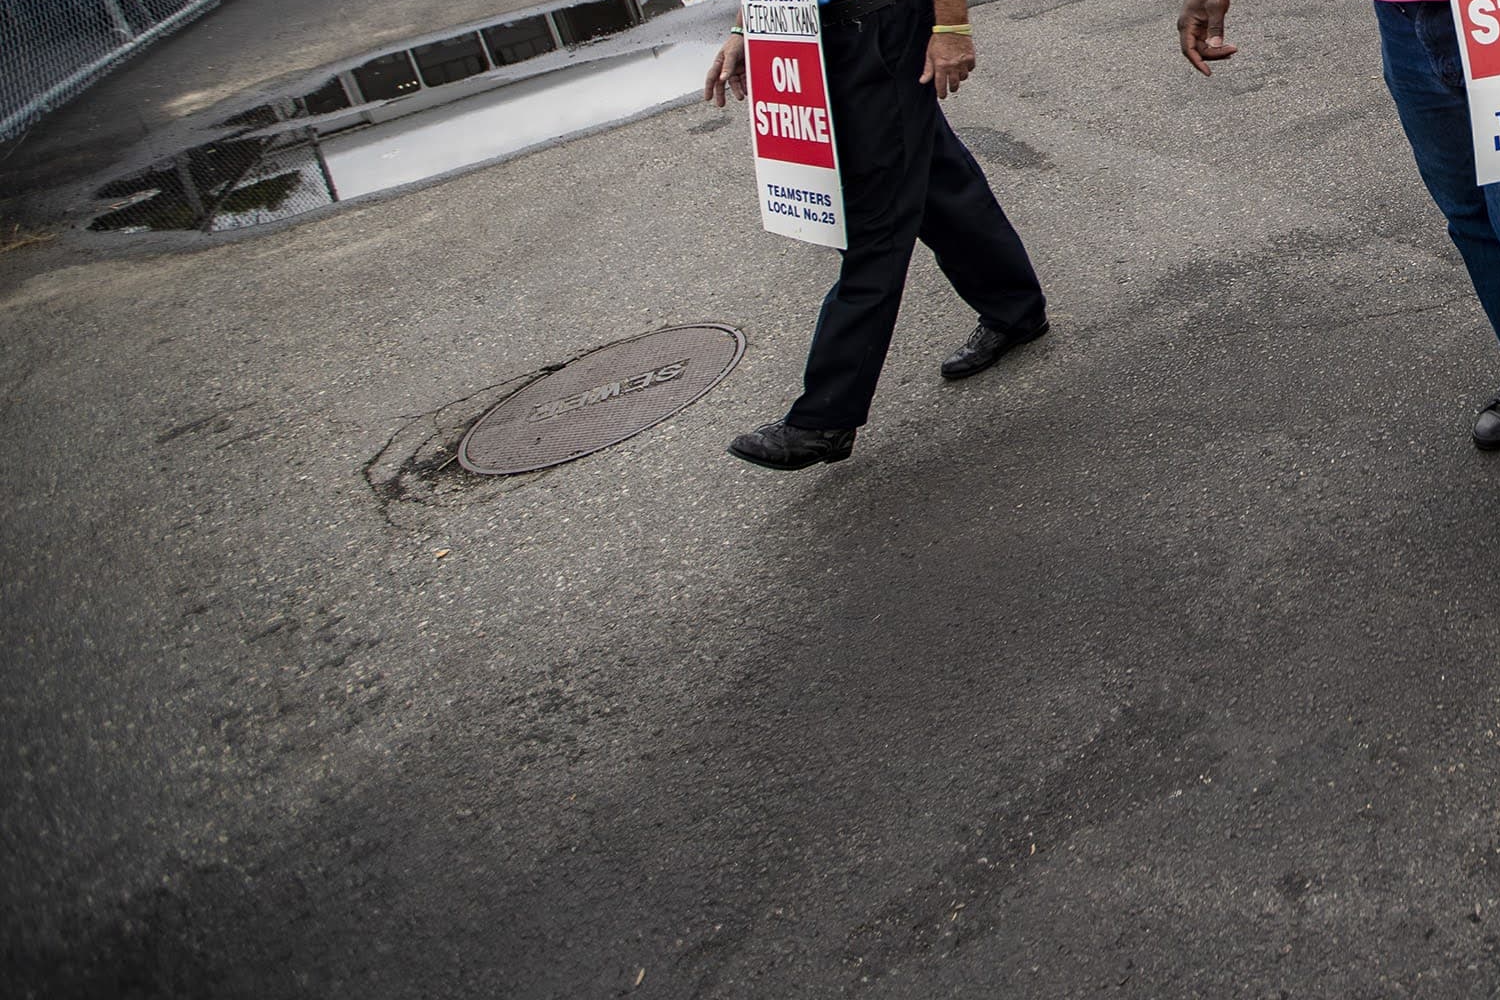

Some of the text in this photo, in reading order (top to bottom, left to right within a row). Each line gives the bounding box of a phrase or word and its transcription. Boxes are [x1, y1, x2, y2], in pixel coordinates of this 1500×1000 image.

[743, 4, 818, 35] VETERANS TRANS
[772, 57, 802, 93] ON
[755, 101, 830, 143] STRIKE
[767, 184, 832, 207] TEAMSTERS
[768, 200, 836, 225] LOCAL No.25
